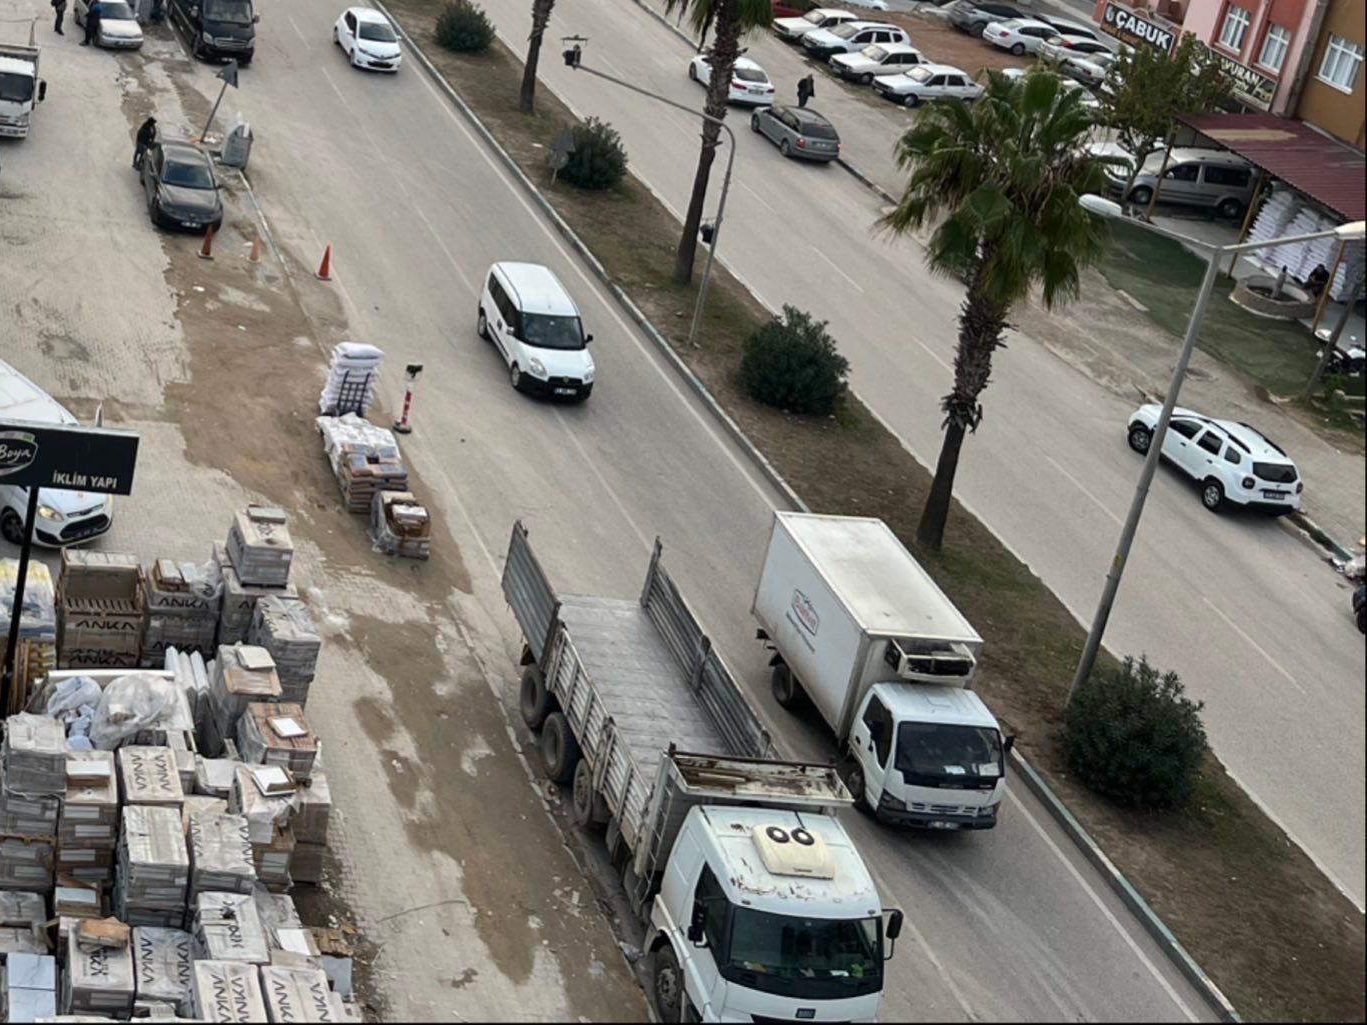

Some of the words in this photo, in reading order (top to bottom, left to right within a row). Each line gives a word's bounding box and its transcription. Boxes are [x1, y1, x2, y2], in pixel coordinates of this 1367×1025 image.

[1115, 10, 1171, 50] ÇABUK
[52, 469, 87, 487] İKLİM
[90, 476, 118, 489] YAPI
[158, 596, 210, 610] ANKA
[75, 619, 136, 631] ANKA
[130, 753, 148, 792] ANKA
[153, 753, 175, 793] ANKA
[139, 936, 155, 984] ANKA
[271, 979, 295, 1023] ANK
[310, 982, 333, 1023] NKA
